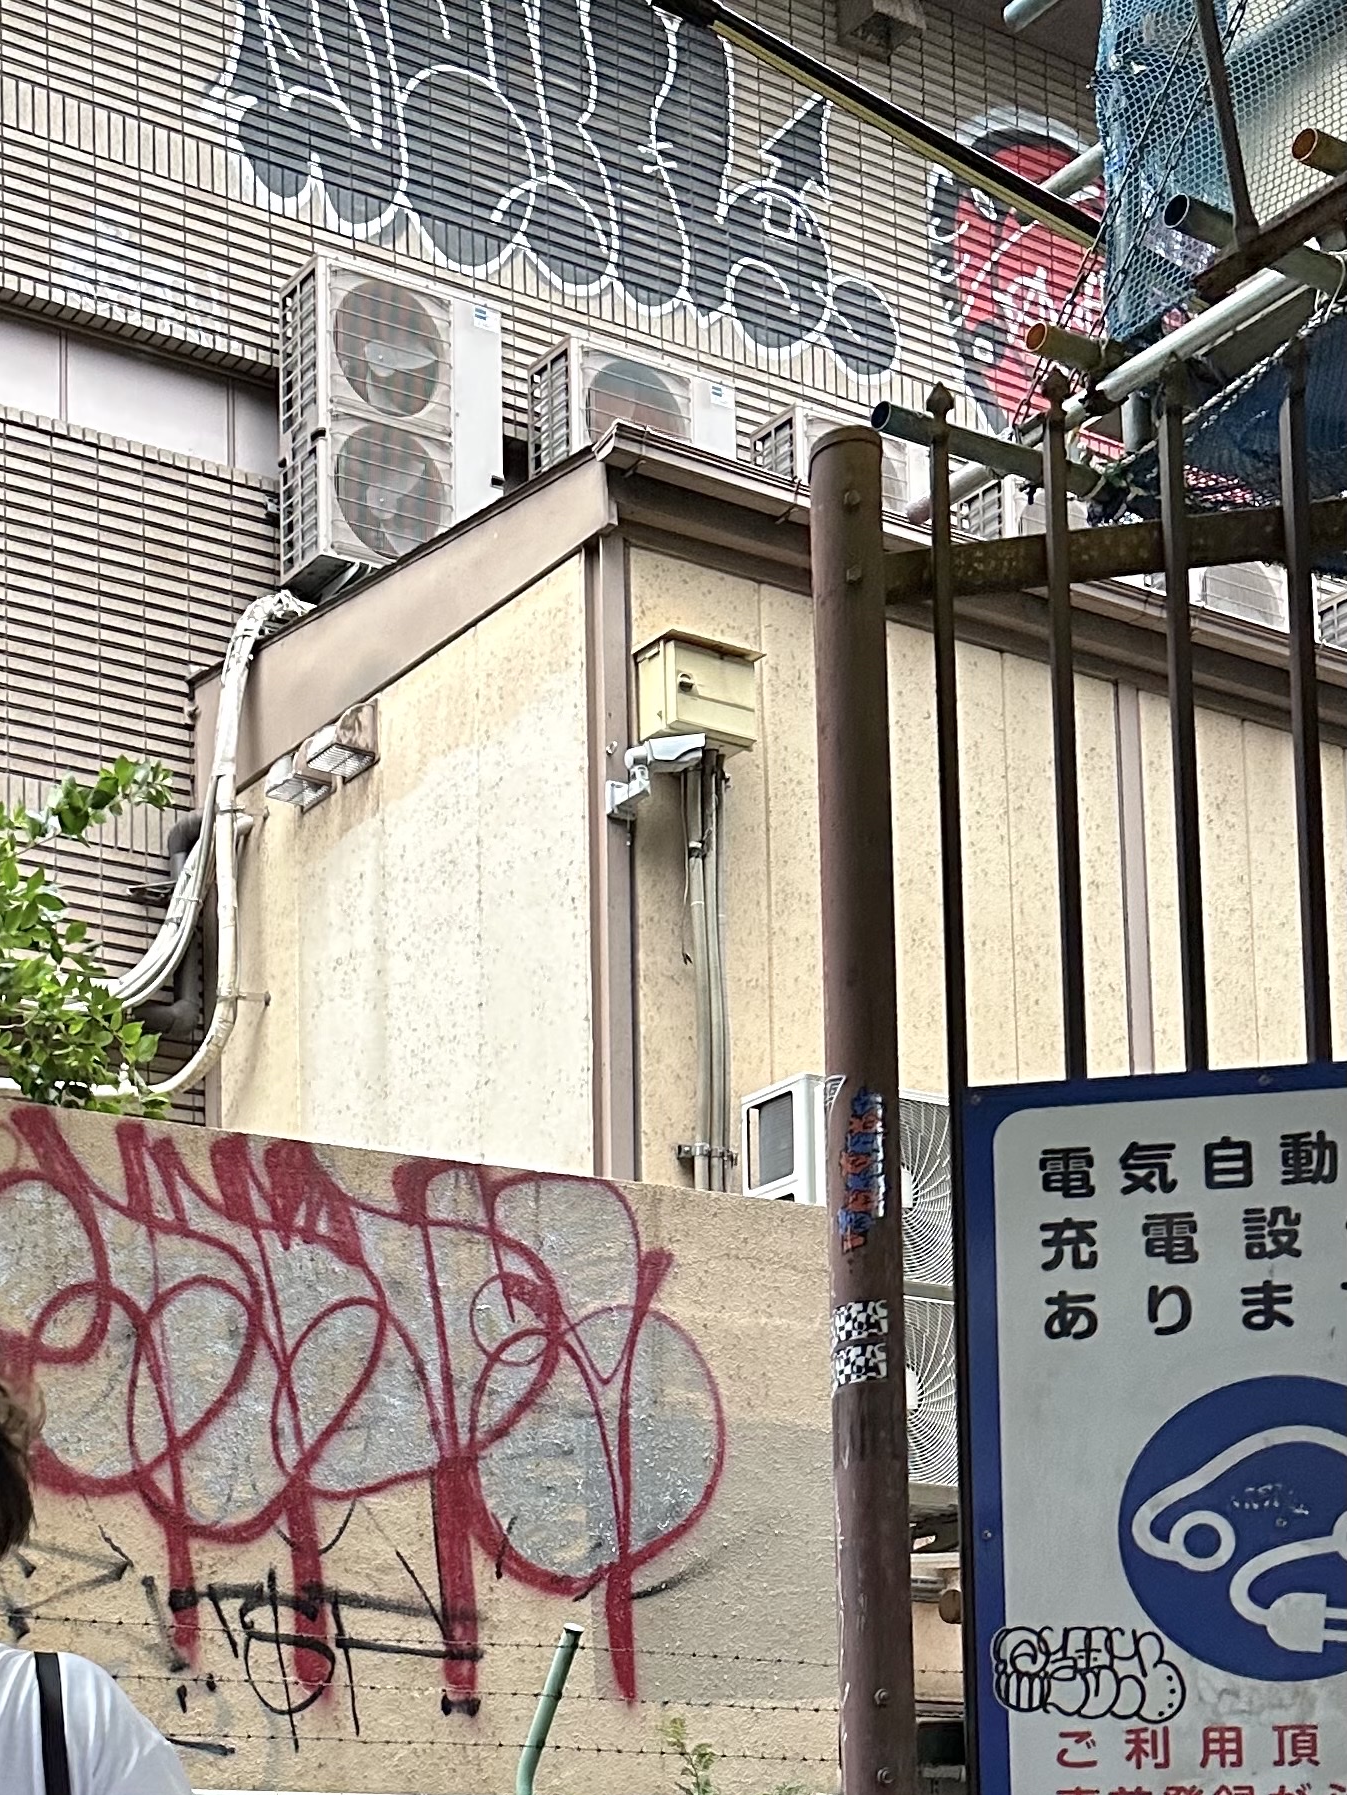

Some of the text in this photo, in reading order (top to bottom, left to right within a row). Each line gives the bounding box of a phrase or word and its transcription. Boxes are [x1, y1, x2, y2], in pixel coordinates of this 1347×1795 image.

[1039, 1130, 1338, 1198] 電気自動
[1039, 1206, 1347, 1271] 充電設
[1044, 1279, 1347, 1340] ありま
[1056, 1724, 1321, 1770] ご利用頂
